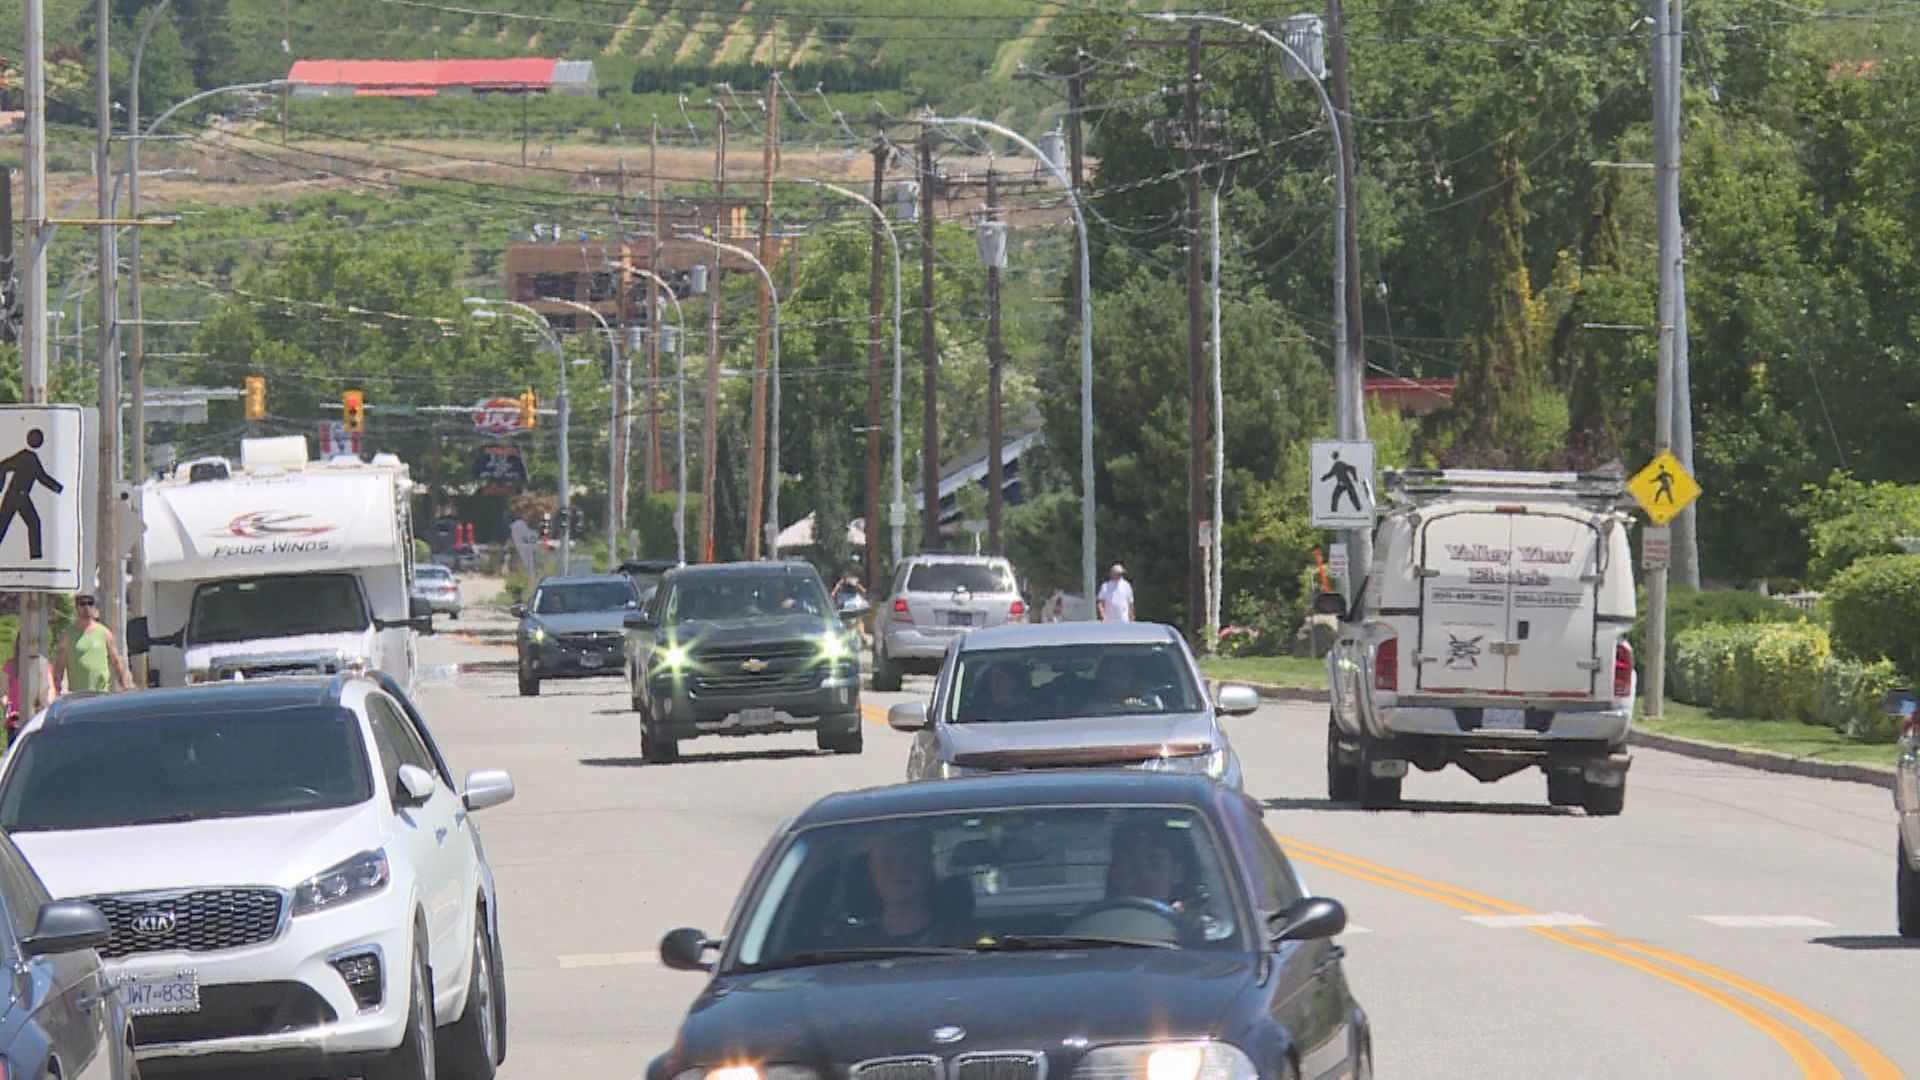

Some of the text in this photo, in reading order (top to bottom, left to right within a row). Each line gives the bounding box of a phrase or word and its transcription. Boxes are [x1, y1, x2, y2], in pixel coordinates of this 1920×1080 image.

[213, 539, 330, 558] FOUR WINDS
[1445, 543, 1575, 565] Valley View
[138, 916, 169, 931] KIA
